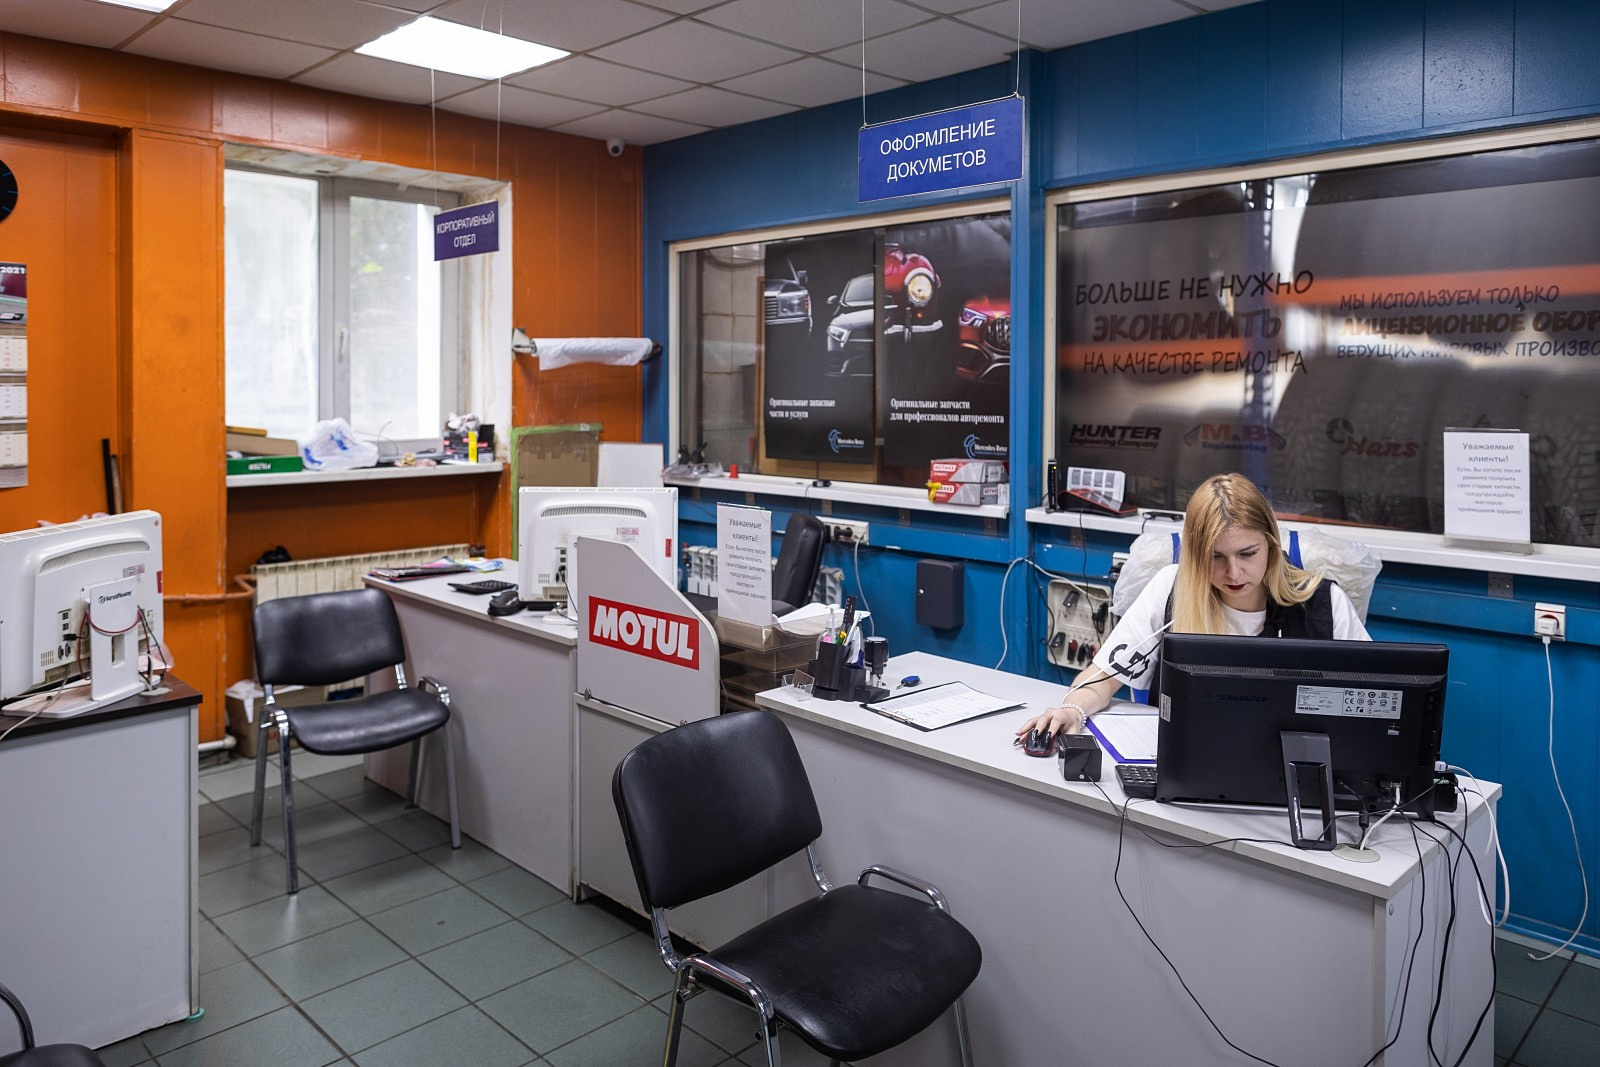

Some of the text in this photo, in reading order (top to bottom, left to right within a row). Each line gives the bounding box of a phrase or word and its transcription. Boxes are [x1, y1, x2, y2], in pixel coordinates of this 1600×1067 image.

[880, 118, 996, 155] ОФОРМЛЕНИЕ
[886, 149, 987, 183] ДОКУМЕТОВ
[436, 210, 495, 234] КОРПОРАТИВНЫЙ
[453, 233, 476, 248] ОТДЕЛ
[0, 266, 25, 274] 2021
[1076, 269, 1314, 306] БОЛЬШЕ НЕ НУЖНО
[1339, 285, 1560, 310] МЫ ИСПОЛЬЗУЕМ ТОЛЬКО
[1092, 308, 1282, 343] ЭКОНОМИТЬ
[1341, 309, 1600, 338] ЛИЦЕНЗИОННОЕ ОБОР
[1337, 344, 1416, 360] ВЕДУЩИХ
[1515, 339, 1600, 357] ПРОИЗВО
[1083, 350, 1308, 375] НА КАЧЕСТВЕ РЕМОНТА
[769, 398, 836, 408] Оригинальные запасные
[890, 398, 971, 410] Оригинальные запчасти
[790, 411, 809, 420] услуги
[890, 412, 1005, 425] для профессионалов авторемонта
[1071, 423, 1162, 440] HUNTER
[1202, 423, 1267, 441] M&B
[1068, 437, 1158, 449] Engineering Company
[1202, 441, 1267, 453] Engineering
[1463, 443, 1515, 451] Уважаемые
[1468, 455, 1509, 463] клиенты!
[728, 517, 762, 530] Уважаемые
[732, 533, 759, 543] клиенты!
[105, 591, 133, 602] kraftway
[593, 604, 694, 661] MOTUL
